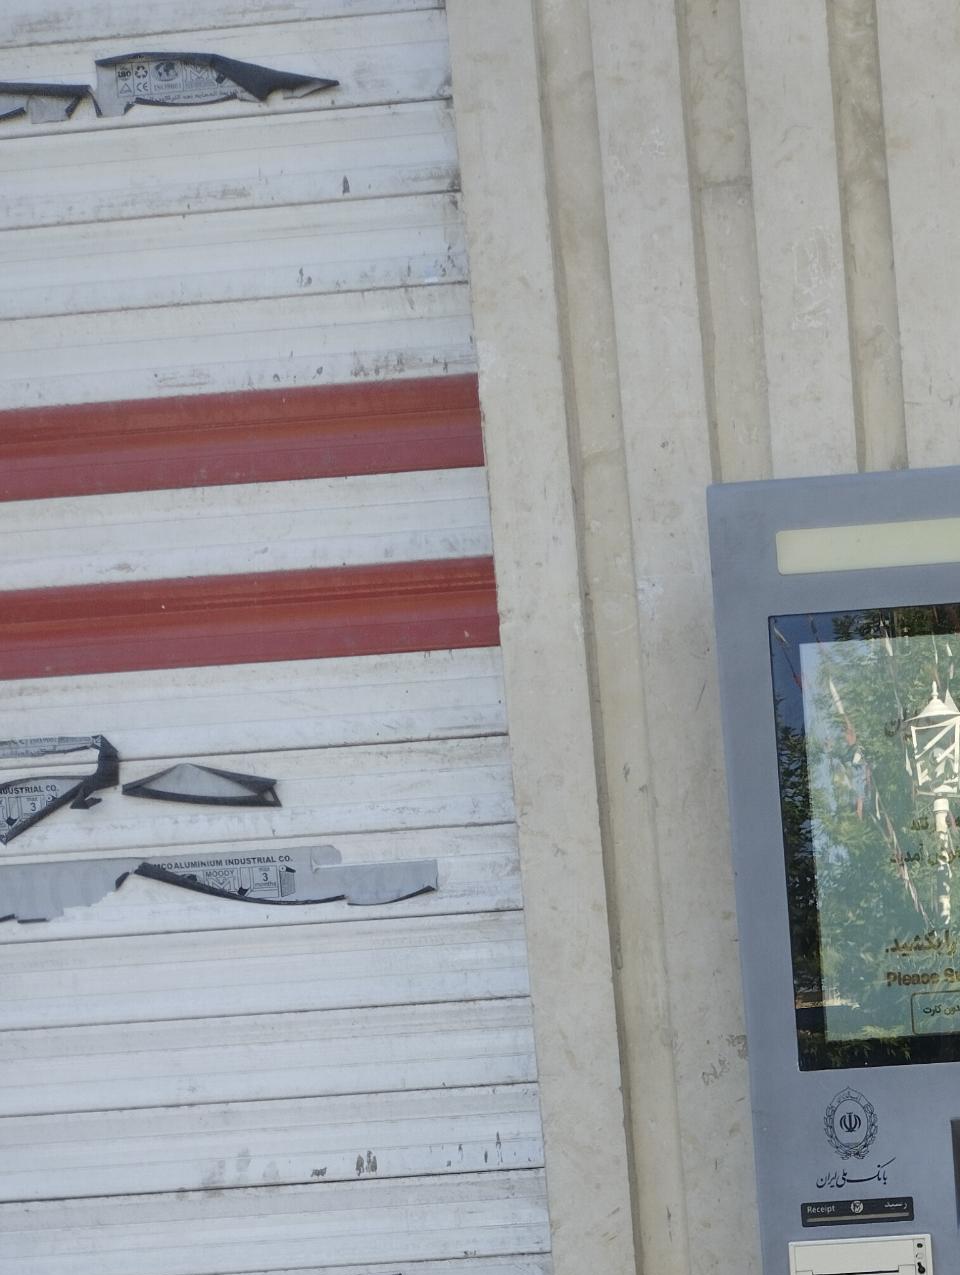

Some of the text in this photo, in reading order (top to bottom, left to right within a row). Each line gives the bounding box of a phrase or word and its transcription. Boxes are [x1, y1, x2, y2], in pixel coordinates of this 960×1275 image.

[30, 802, 37, 812] 3
[173, 859, 223, 869] ALUMINIUM
[225, 857, 277, 866] INDUSTRIAL
[205, 870, 235, 878] MOODY
[262, 872, 269, 882] 3
[806, 1203, 836, 1214] Receipt
[884, 1201, 908, 1210] رسید
